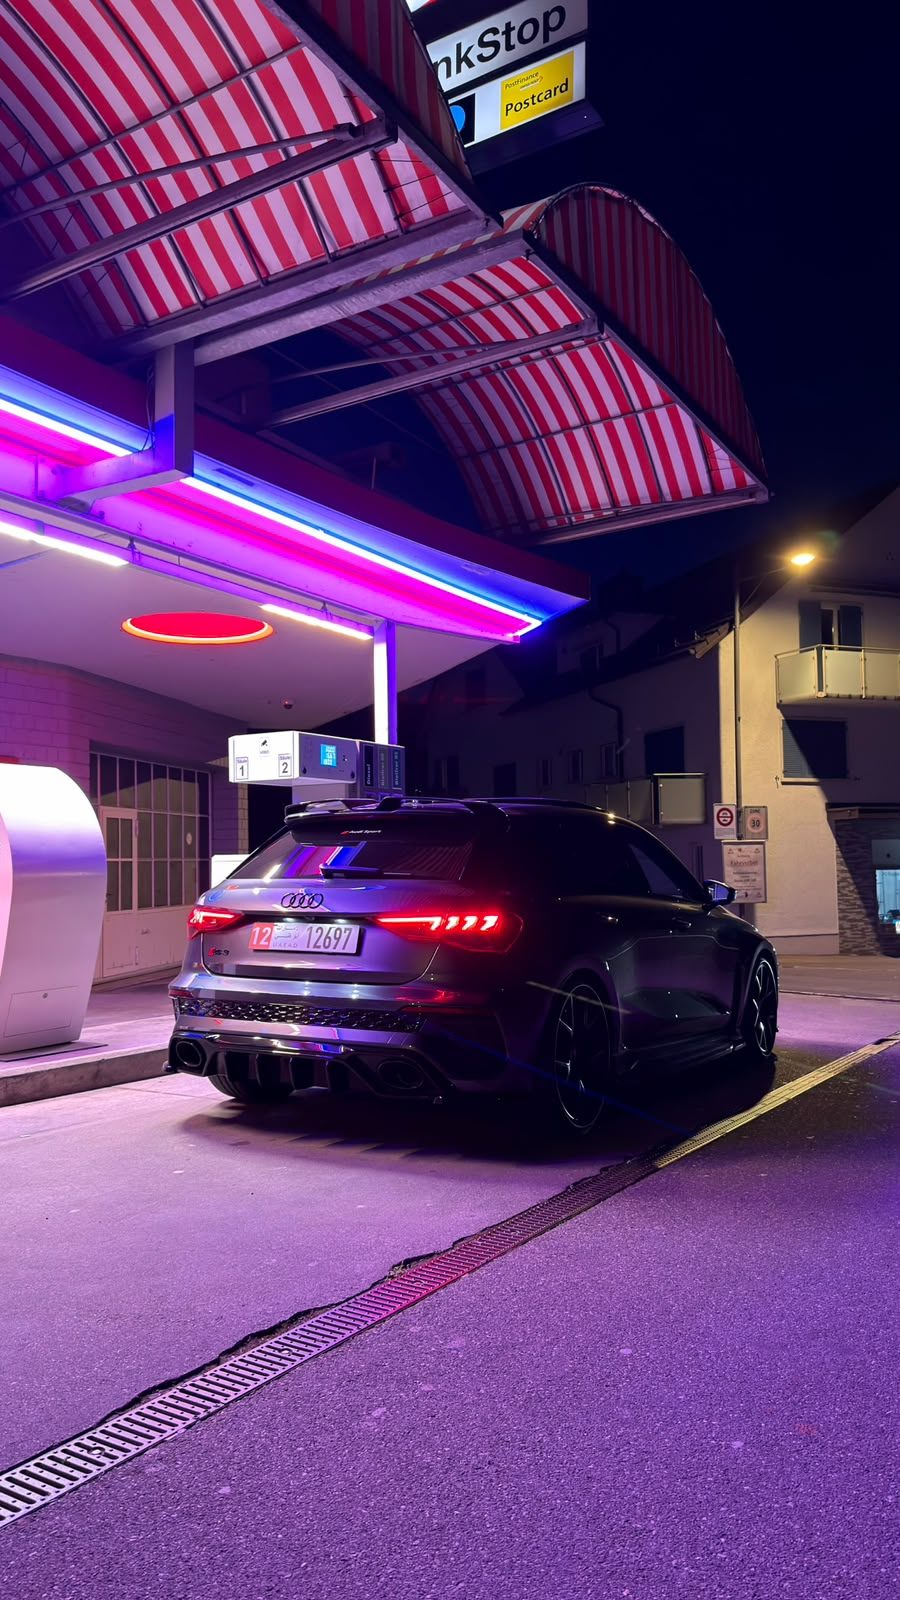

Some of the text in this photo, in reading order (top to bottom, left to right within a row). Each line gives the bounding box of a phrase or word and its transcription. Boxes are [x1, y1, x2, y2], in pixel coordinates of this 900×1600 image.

[504, 71, 540, 90] PostFinance
[505, 78, 569, 117] Postcard
[239, 764, 244, 777] 1
[281, 761, 288, 774] 2
[751, 819, 760, 828] 30
[252, 926, 353, 950] 12 12697
